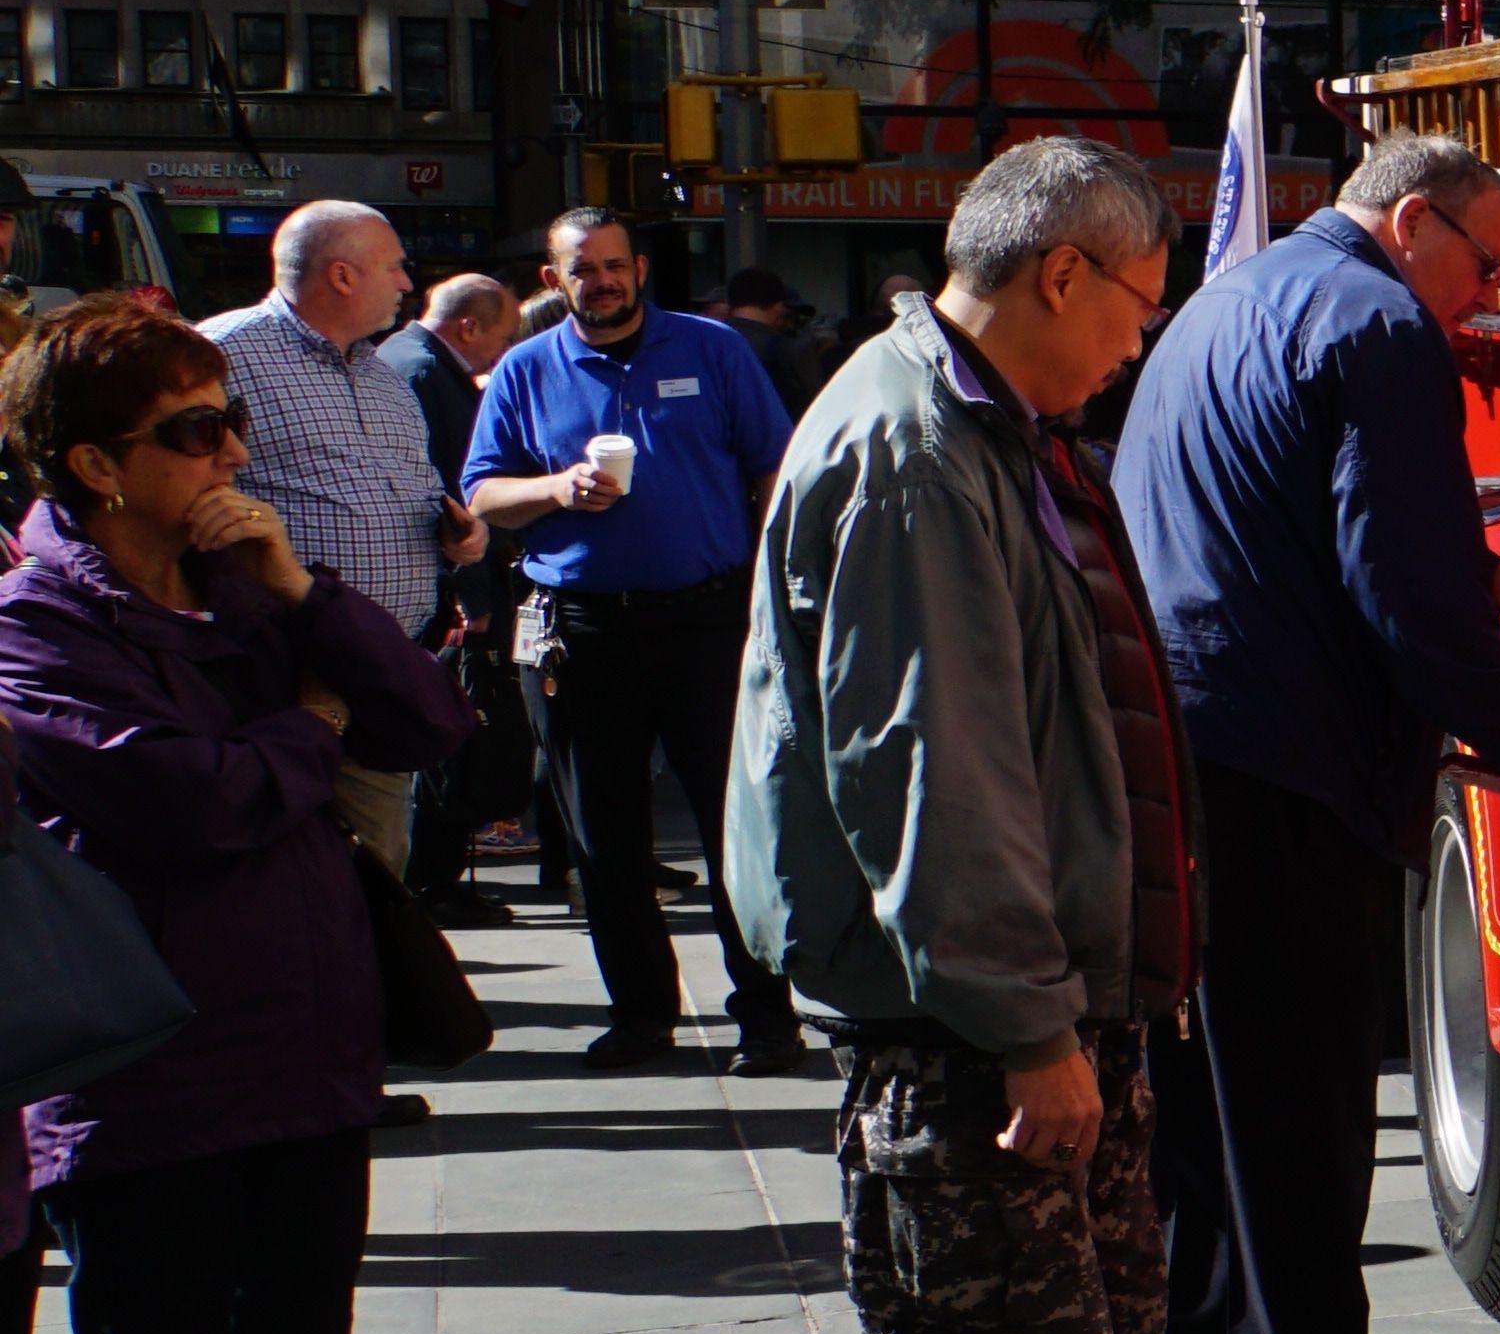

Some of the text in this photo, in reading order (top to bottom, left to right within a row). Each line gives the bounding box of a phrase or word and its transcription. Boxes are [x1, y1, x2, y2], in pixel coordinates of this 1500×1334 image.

[147, 162, 223, 178] DUANE
[243, 188, 285, 198] company
[867, 178, 900, 208] IN
